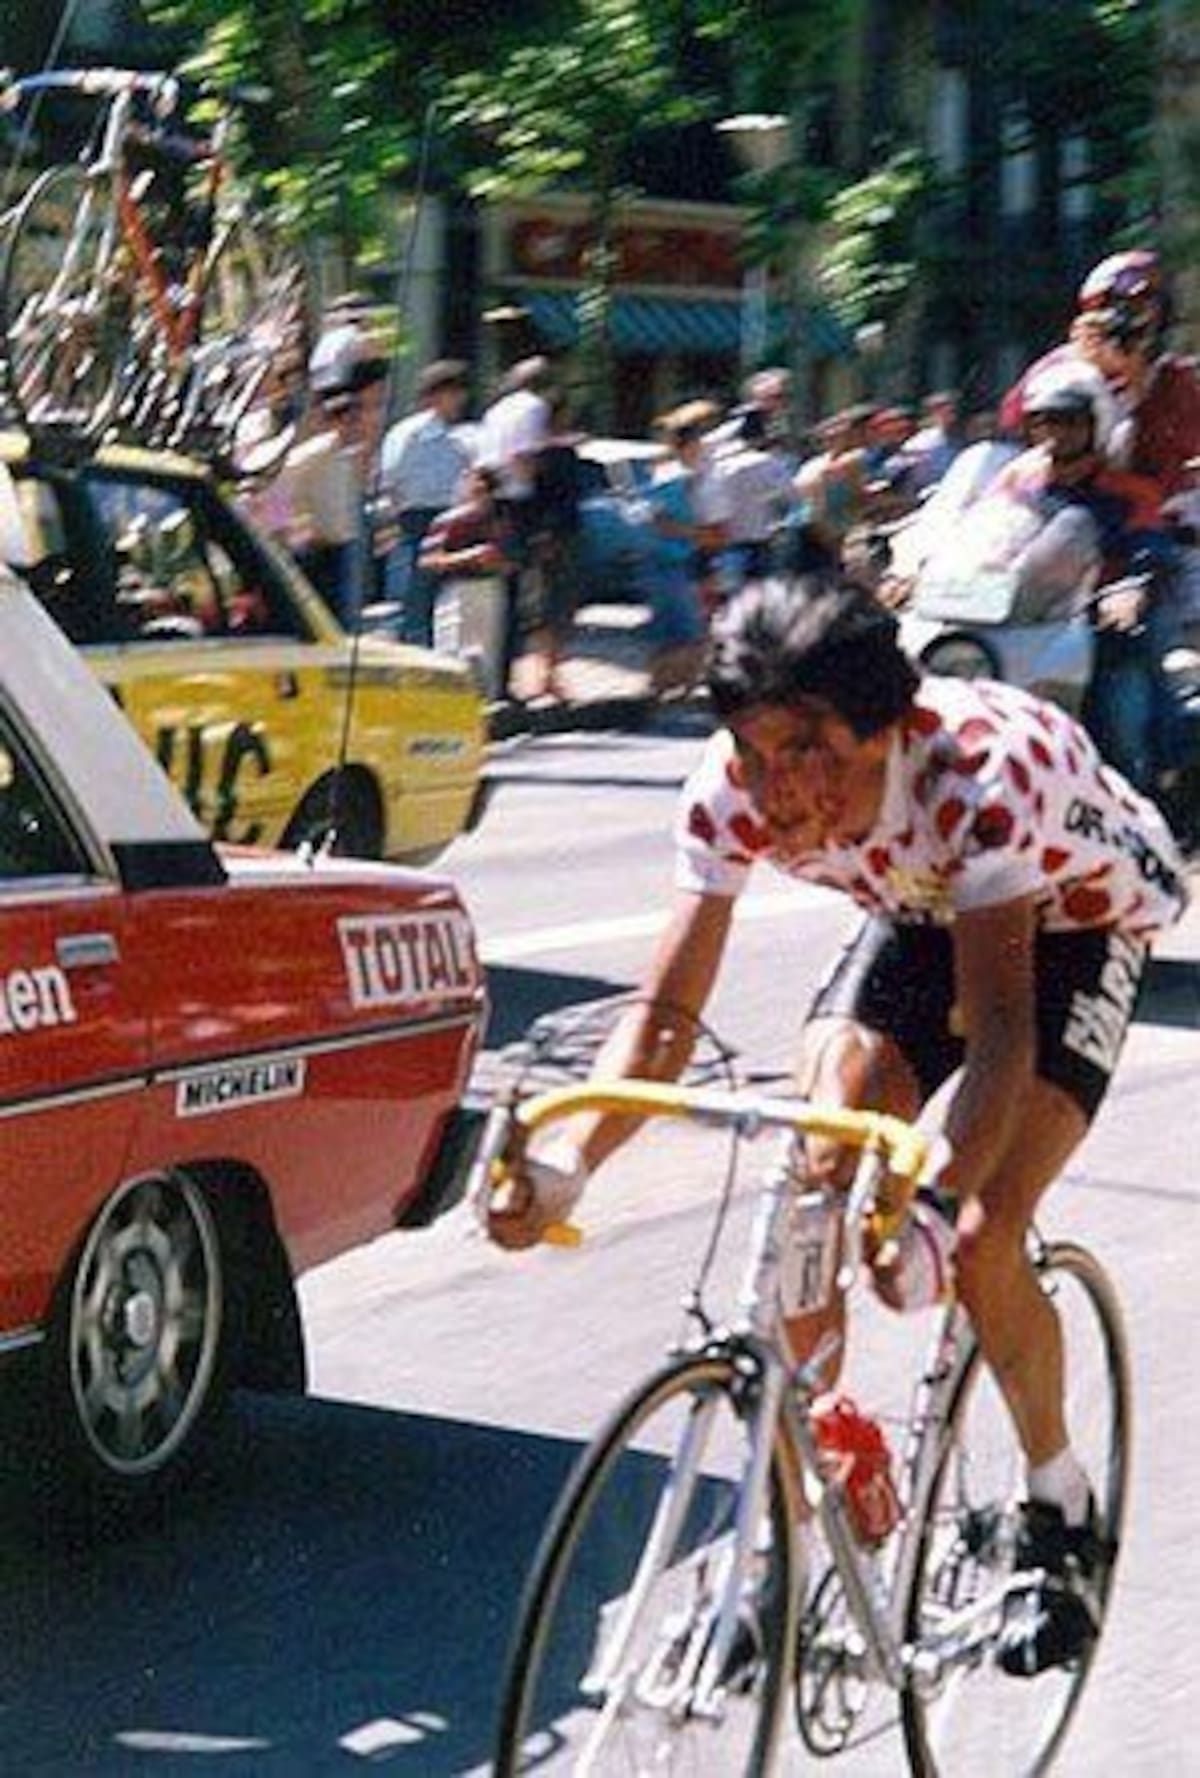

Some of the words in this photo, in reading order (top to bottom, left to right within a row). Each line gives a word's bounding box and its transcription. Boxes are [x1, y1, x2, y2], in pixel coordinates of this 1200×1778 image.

[346, 919, 471, 999] TOTAL
[0, 966, 77, 1034] en
[185, 1064, 297, 1108] MICHELIN
